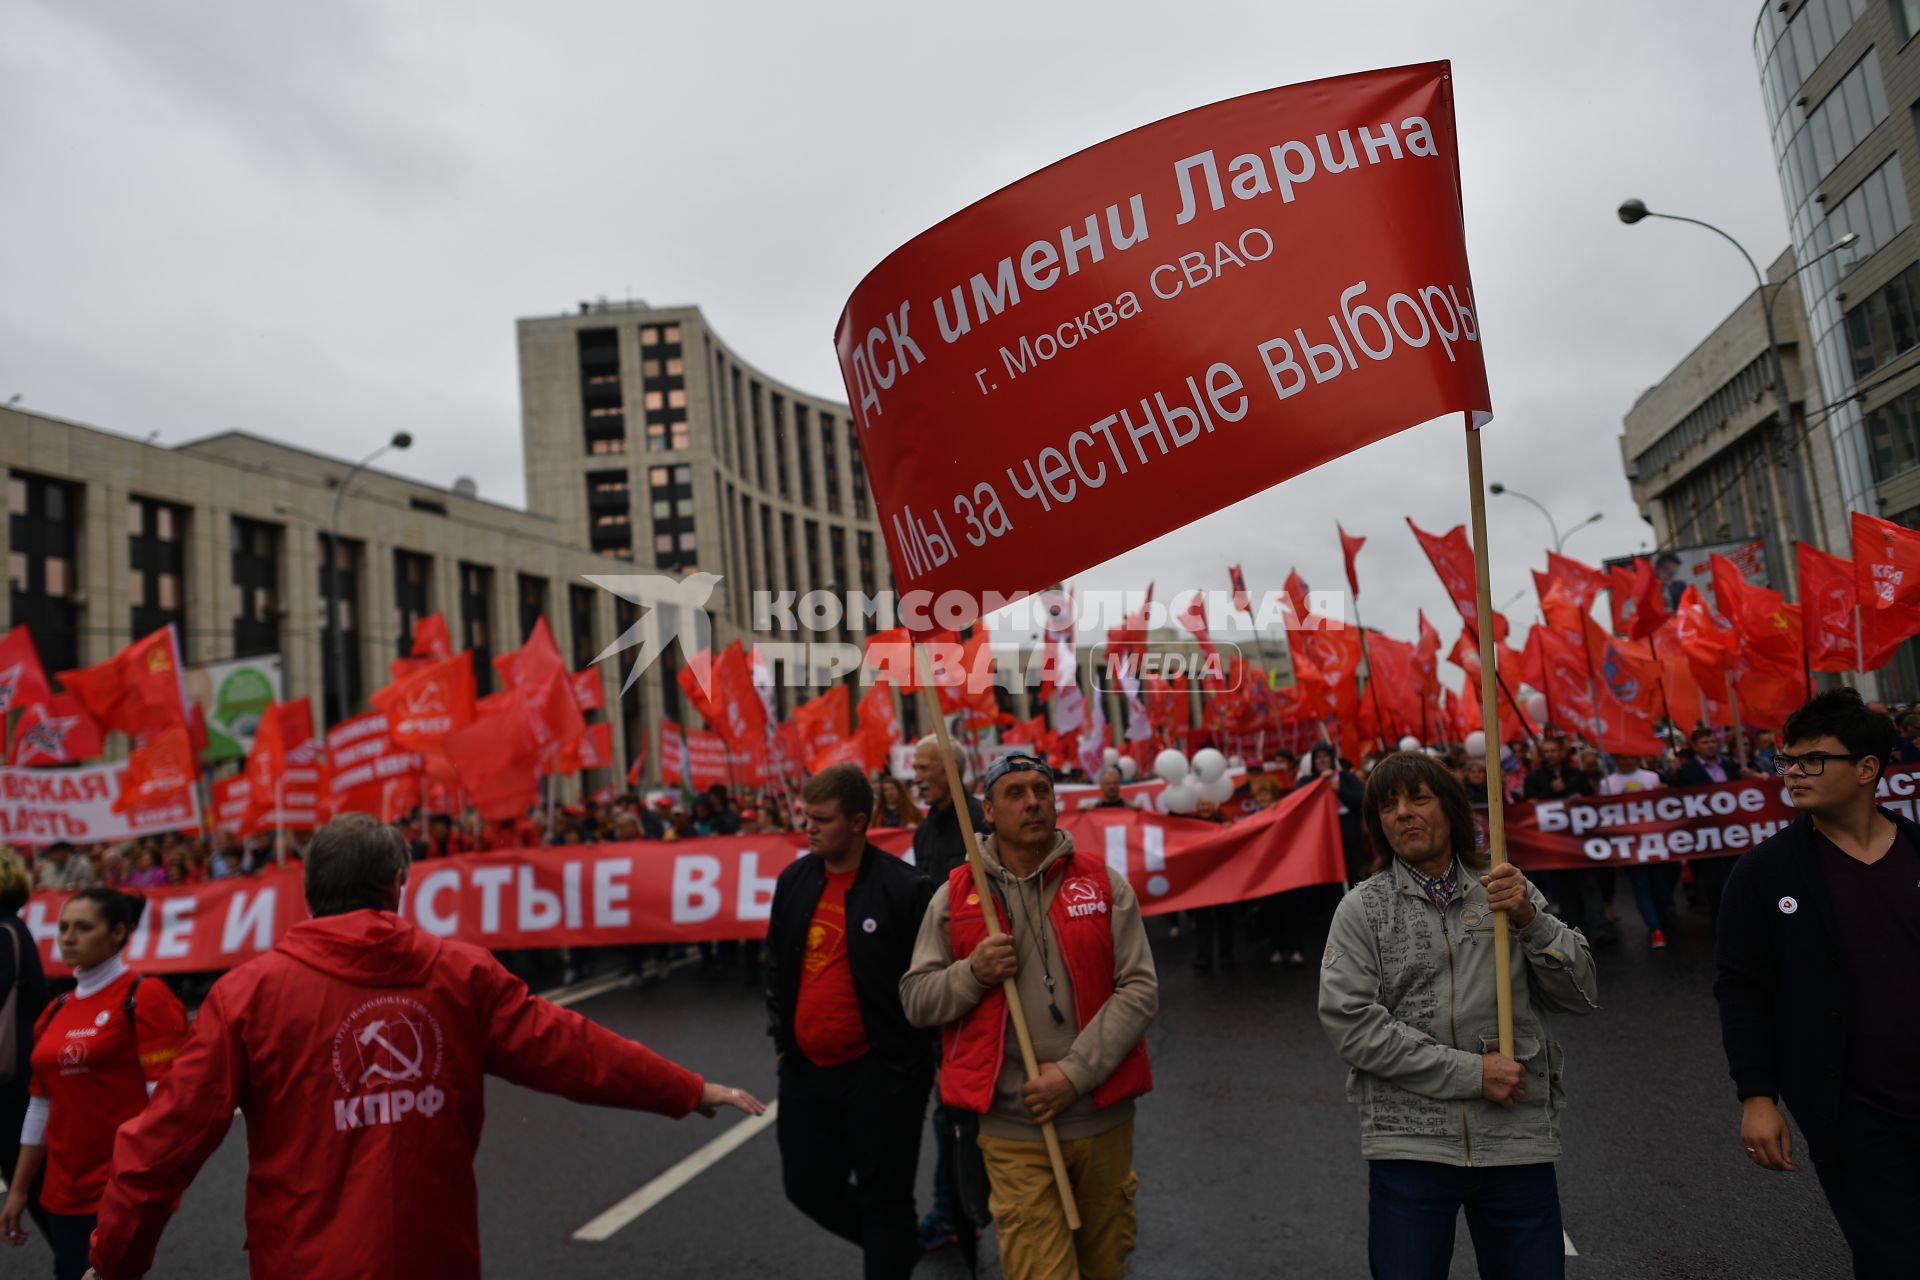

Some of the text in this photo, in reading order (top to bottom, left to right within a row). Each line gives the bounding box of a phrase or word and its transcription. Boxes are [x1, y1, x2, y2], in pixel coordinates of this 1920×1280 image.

[851, 115, 1438, 429] ДСК имени Ларина
[974, 226, 1275, 396] г. Москва СВАО
[892, 280, 1481, 582] Мы за честные выборы
[1535, 787, 1766, 835] Брянское
[221, 886, 277, 953] И
[398, 858, 634, 937] СТЫЕ
[1067, 900, 1107, 918] КПРФ
[333, 1084, 446, 1131] КПРФ
